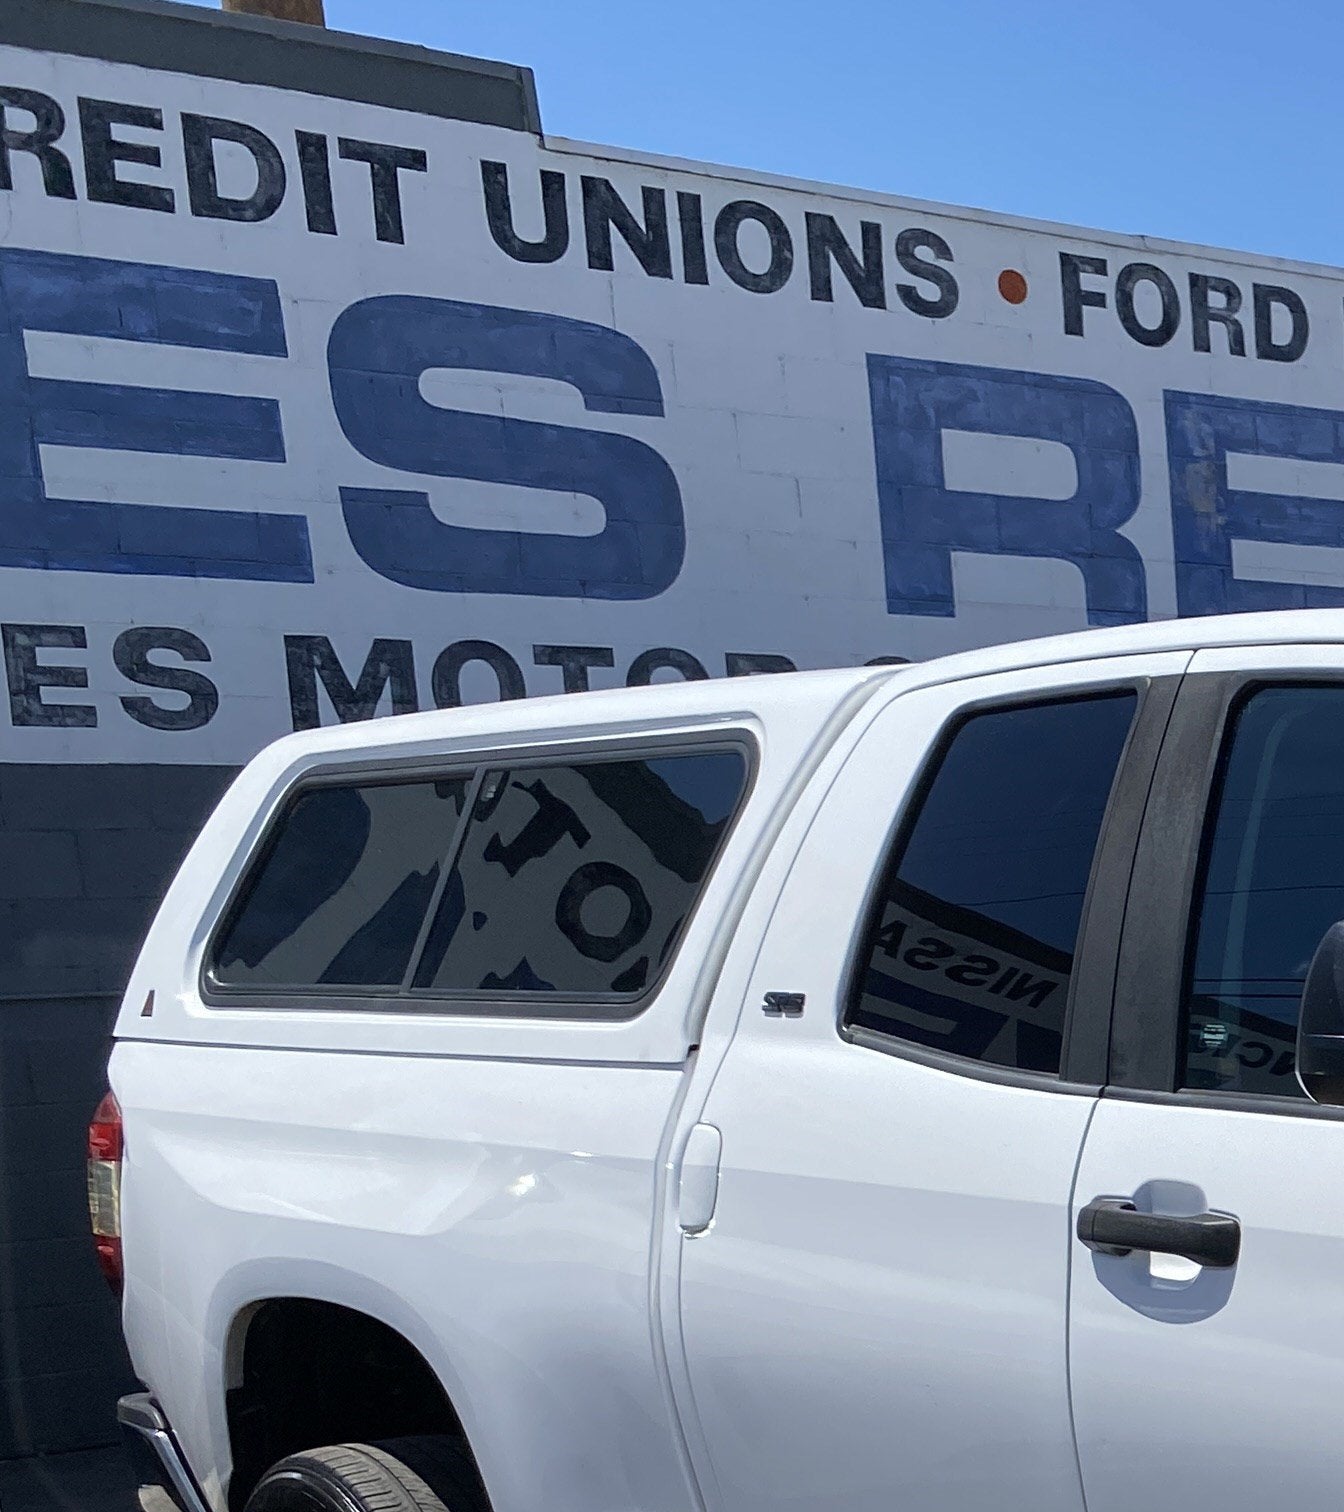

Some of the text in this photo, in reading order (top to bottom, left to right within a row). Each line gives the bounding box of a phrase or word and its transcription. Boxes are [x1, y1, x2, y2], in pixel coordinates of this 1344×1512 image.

[480, 160, 958, 318] UNIONS
[1059, 251, 1309, 363] FORD
[3, 623, 797, 732] ES MOT
